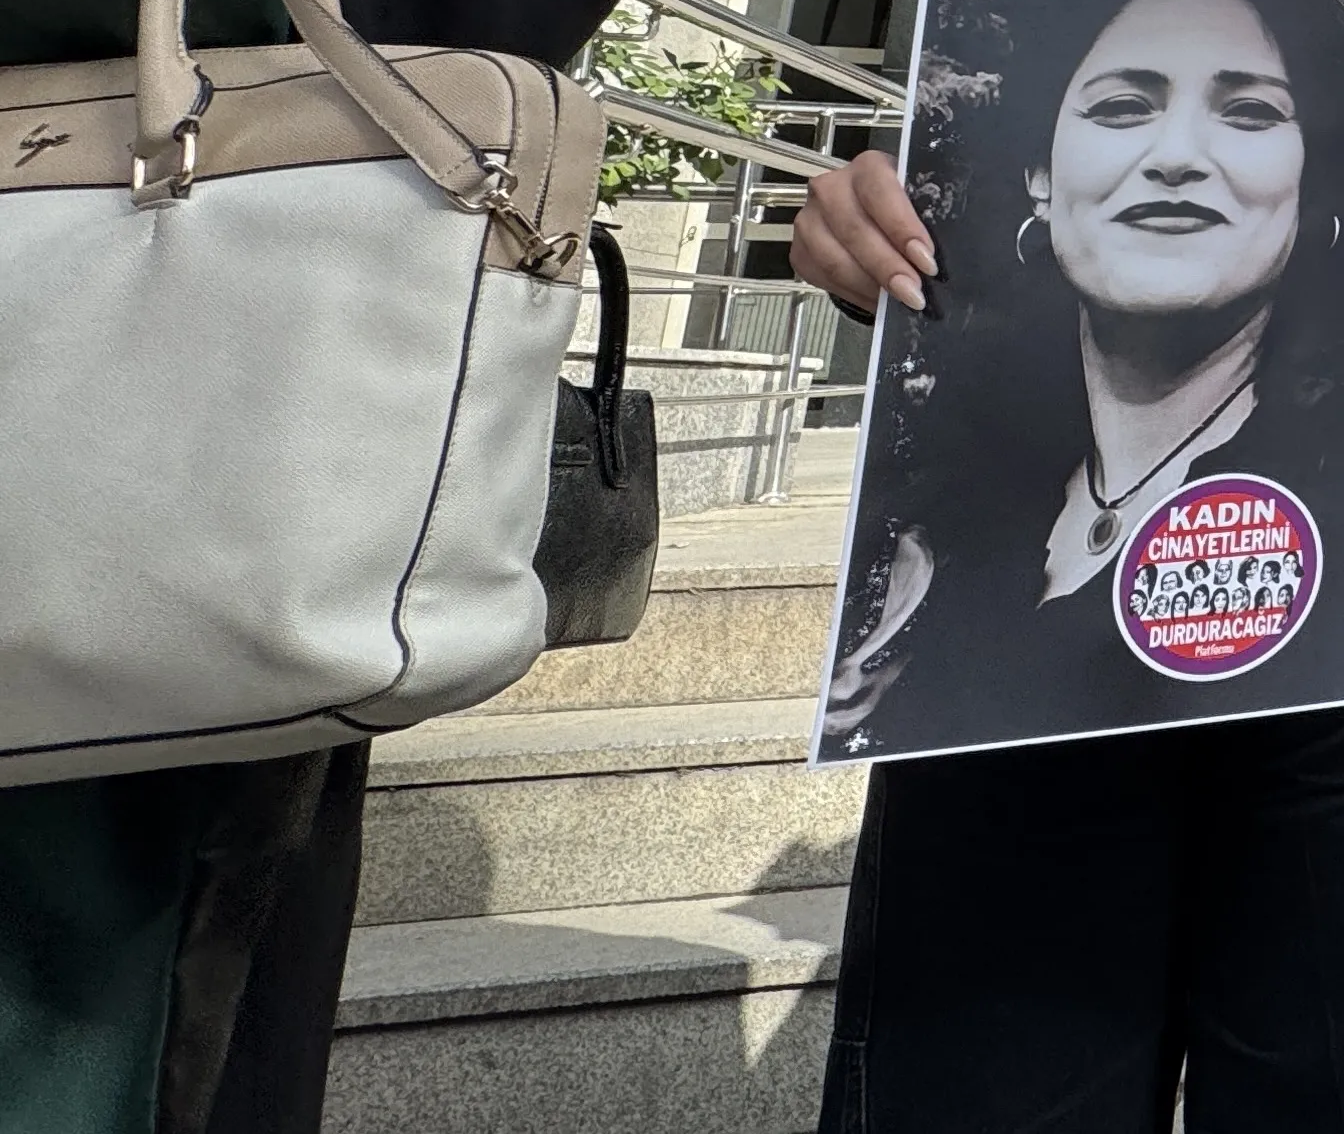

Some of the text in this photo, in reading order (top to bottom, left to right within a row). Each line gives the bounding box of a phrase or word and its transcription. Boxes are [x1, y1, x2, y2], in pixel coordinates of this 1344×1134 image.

[1168, 499, 1276, 532] KADIN
[1148, 522, 1291, 560] CİNAYETLERİNİ
[1149, 608, 1283, 648] DURDURACAĞIZ
